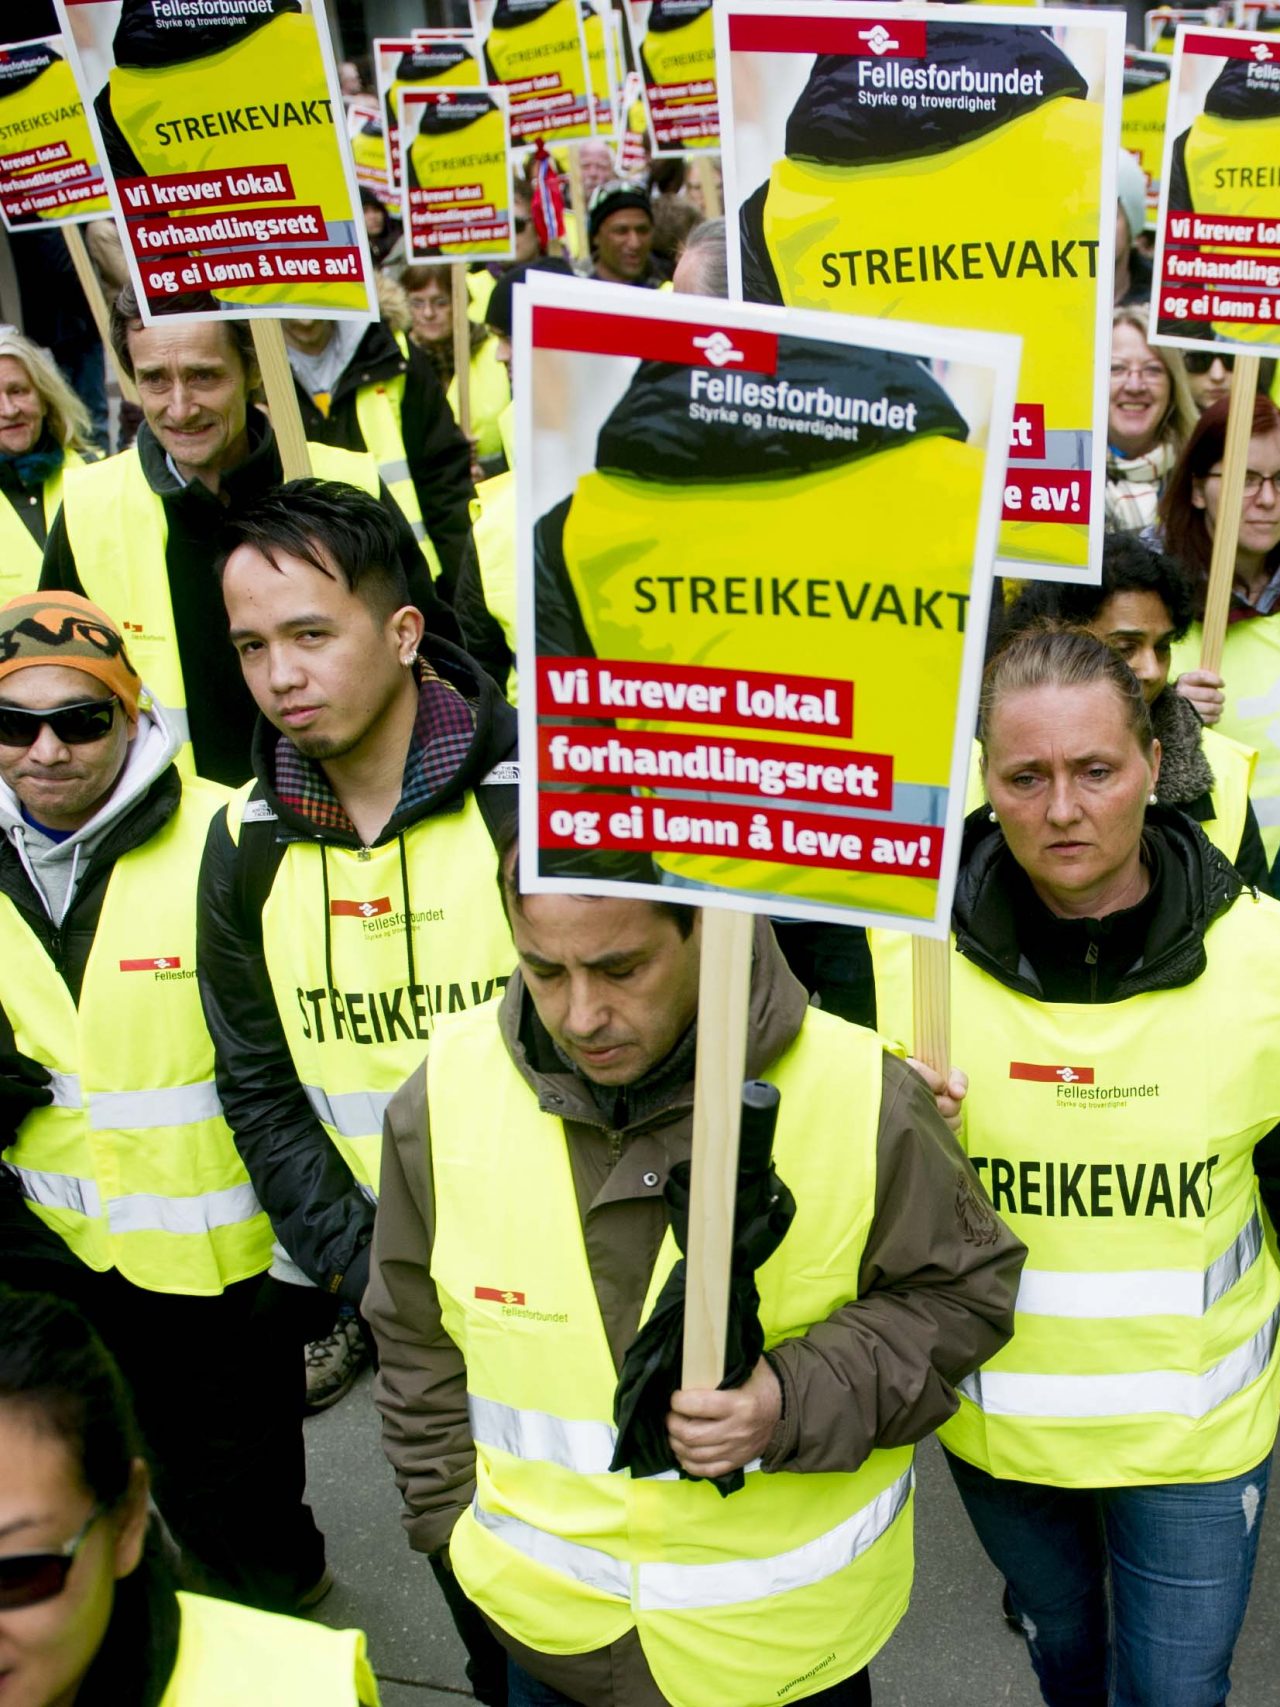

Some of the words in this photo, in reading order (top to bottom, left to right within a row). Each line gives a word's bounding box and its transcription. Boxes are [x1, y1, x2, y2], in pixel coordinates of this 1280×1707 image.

[153, 0, 274, 17] Fellesforbundet
[156, 18, 182, 28] Styrke
[185, 18, 196, 28] og
[197, 16, 247, 26] troverdighet
[858, 61, 1043, 95] Fellesforbundet
[858, 90, 897, 107] Styrke
[902, 96, 916, 109] og
[921, 94, 996, 113] troverdighet
[0, 102, 86, 140] STREIKEVAKT
[156, 100, 334, 146] STREIKEVAKT
[37, 144, 68, 163] lokal
[124, 184, 150, 207] Vi
[151, 179, 222, 205] krever
[226, 171, 286, 198] lokal
[6, 202, 21, 215] og
[137, 214, 318, 248] forhandlingsrett
[1171, 218, 1190, 238] Vi
[1193, 219, 1254, 242] krever
[149, 271, 179, 293] og
[181, 264, 202, 285] ei
[203, 261, 254, 283] lønn
[258, 254, 273, 277] å
[275, 255, 321, 276] leve
[325, 253, 358, 275] av!
[822, 240, 1099, 288] STREIKEVAKT
[1164, 297, 1188, 318] og
[1191, 295, 1209, 315] ei
[1212, 296, 1254, 318] lønn
[1258, 297, 1271, 319] å
[690, 369, 918, 432] Fellesforbundet
[688, 402, 738, 425] Styrke
[742, 412, 762, 430] og
[766, 412, 859, 441] troverdighet
[1030, 481, 1080, 512] av!
[633, 575, 971, 633] STREIKEVAKT
[547, 669, 589, 705] Vi
[599, 671, 727, 714] krever
[736, 680, 840, 726] lokal
[549, 735, 880, 798] forhandlingsrett
[549, 809, 600, 846] og
[609, 806, 643, 840] ei
[652, 808, 738, 847] lønn
[749, 813, 773, 851] å
[782, 820, 862, 861] leve
[871, 836, 931, 867] av!
[1056, 1084, 1159, 1100] Fellesforbundet
[969, 1154, 1219, 1218] TREIKEVAKT
